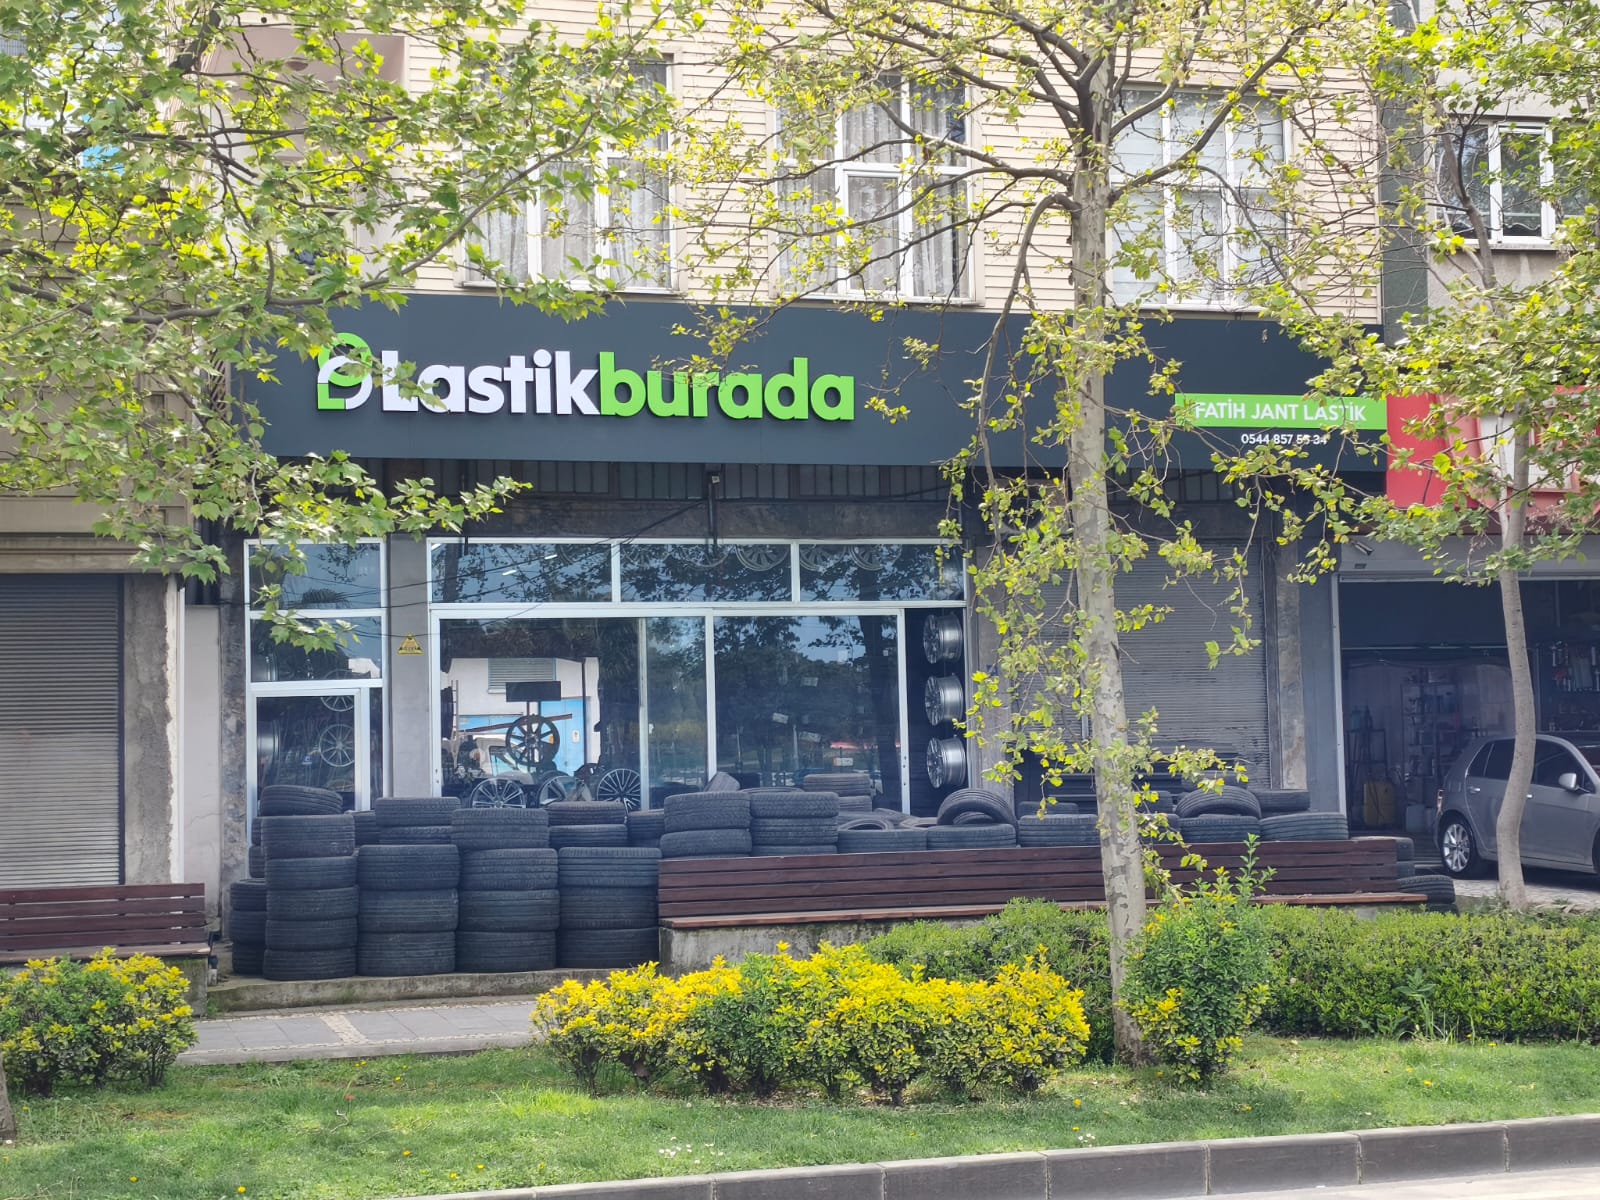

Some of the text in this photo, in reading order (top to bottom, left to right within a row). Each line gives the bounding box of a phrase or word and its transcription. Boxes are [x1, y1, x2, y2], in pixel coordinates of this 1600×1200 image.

[381, 349, 855, 420] Lastikburada
[1195, 399, 1246, 420] FATİH
[1251, 403, 1299, 421] JANT
[1241, 433, 1270, 445] 0544
[1273, 433, 1294, 445] 857
